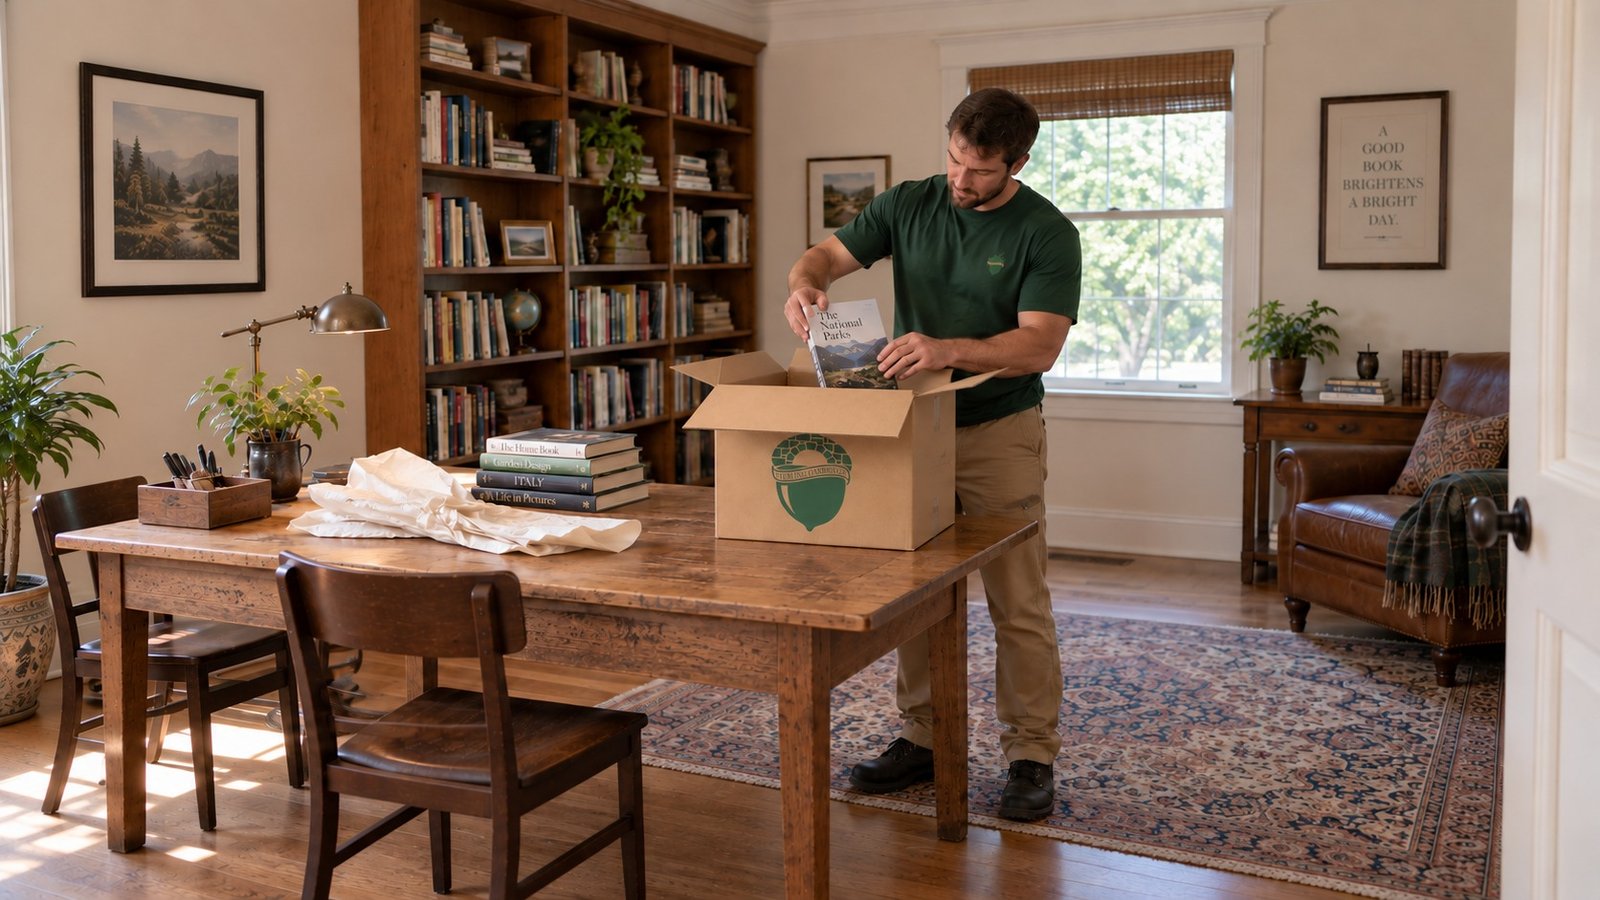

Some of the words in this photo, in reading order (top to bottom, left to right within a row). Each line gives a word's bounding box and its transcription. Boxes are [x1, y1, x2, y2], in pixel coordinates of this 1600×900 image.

[1379, 125, 1388, 136] A
[1362, 142, 1405, 154] GOOD
[1363, 160, 1403, 172] BOOK
[1342, 177, 1424, 191] BRIGHTENS
[1348, 197, 1358, 208] A
[1362, 195, 1417, 208] BRIGHT
[1368, 214, 1399, 226] DAY.
[817, 311, 838, 321] The
[820, 318, 863, 330] National
[823, 330, 851, 341] Parks
[500, 442, 514, 452] The
[515, 443, 538, 454] Home
[539, 444, 559, 456] Book
[493, 458, 523, 468] Garden
[524, 460, 551, 473] Design
[514, 475, 545, 487] ITALY
[495, 491, 513, 502] Life
[514, 494, 522, 502] in
[523, 493, 556, 505] Pictures
